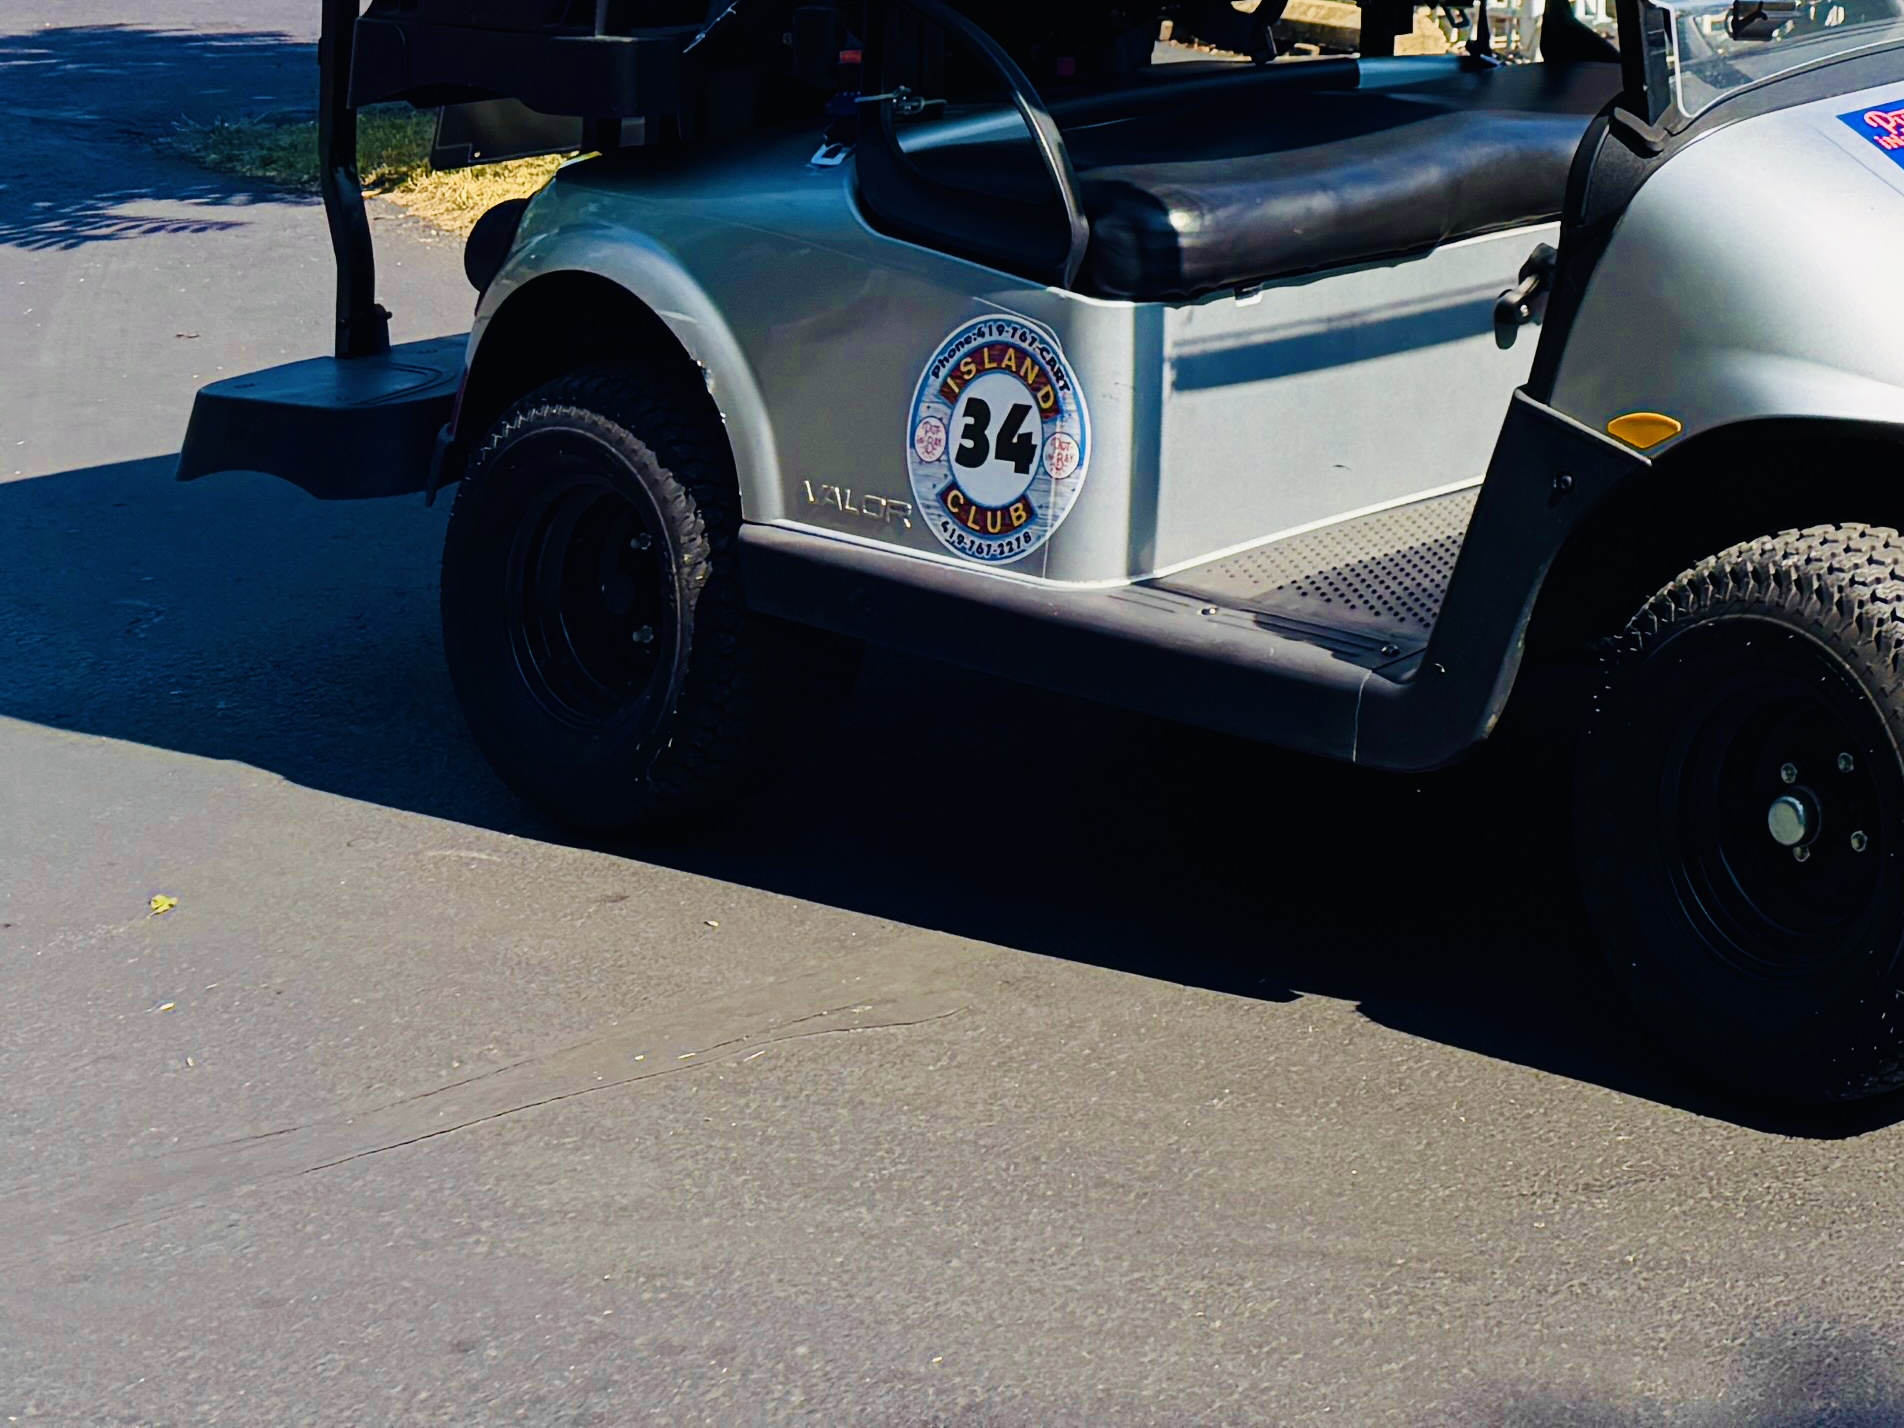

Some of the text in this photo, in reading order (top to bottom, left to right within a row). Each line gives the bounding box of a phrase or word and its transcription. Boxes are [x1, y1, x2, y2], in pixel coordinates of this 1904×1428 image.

[946, 347, 1055, 409] ISLAND
[955, 397, 1037, 475] 34
[947, 489, 1027, 533] CLUB
